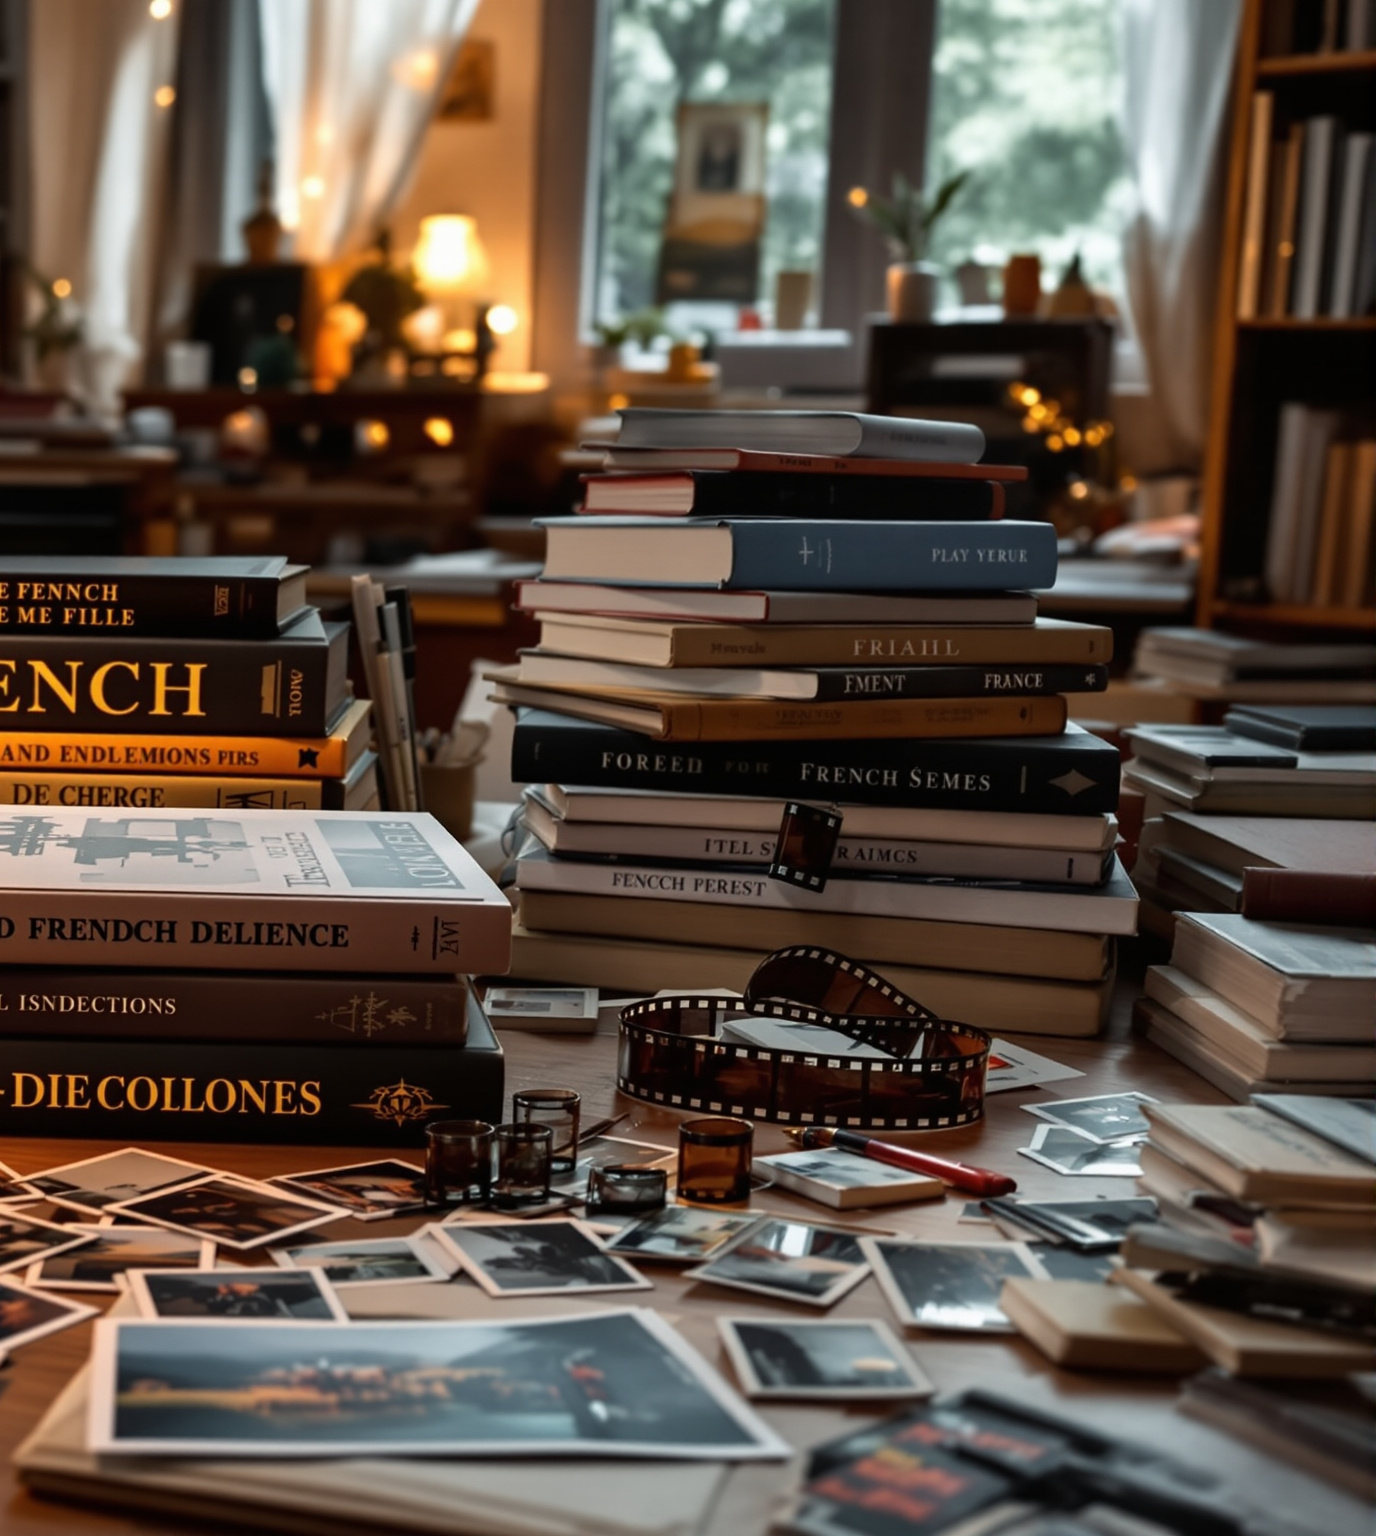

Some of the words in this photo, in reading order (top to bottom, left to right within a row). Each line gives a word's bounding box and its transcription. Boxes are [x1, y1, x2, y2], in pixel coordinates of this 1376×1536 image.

[931, 548, 970, 563] PLAY
[17, 582, 119, 602] FENNCH
[17, 606, 53, 624] ME
[62, 607, 136, 626] FILLE
[983, 672, 1044, 690] FRANCE
[0, 742, 51, 763] AND
[800, 762, 899, 787] FRENCH
[12, 783, 51, 806] DE
[58, 784, 166, 809] CHERGE
[611, 871, 686, 892] FENCCH
[693, 877, 767, 898] PEREST
[28, 916, 178, 944] FRENDCH
[189, 920, 350, 948] DELIENCE
[18, 993, 177, 1016] ISNDECTIONS
